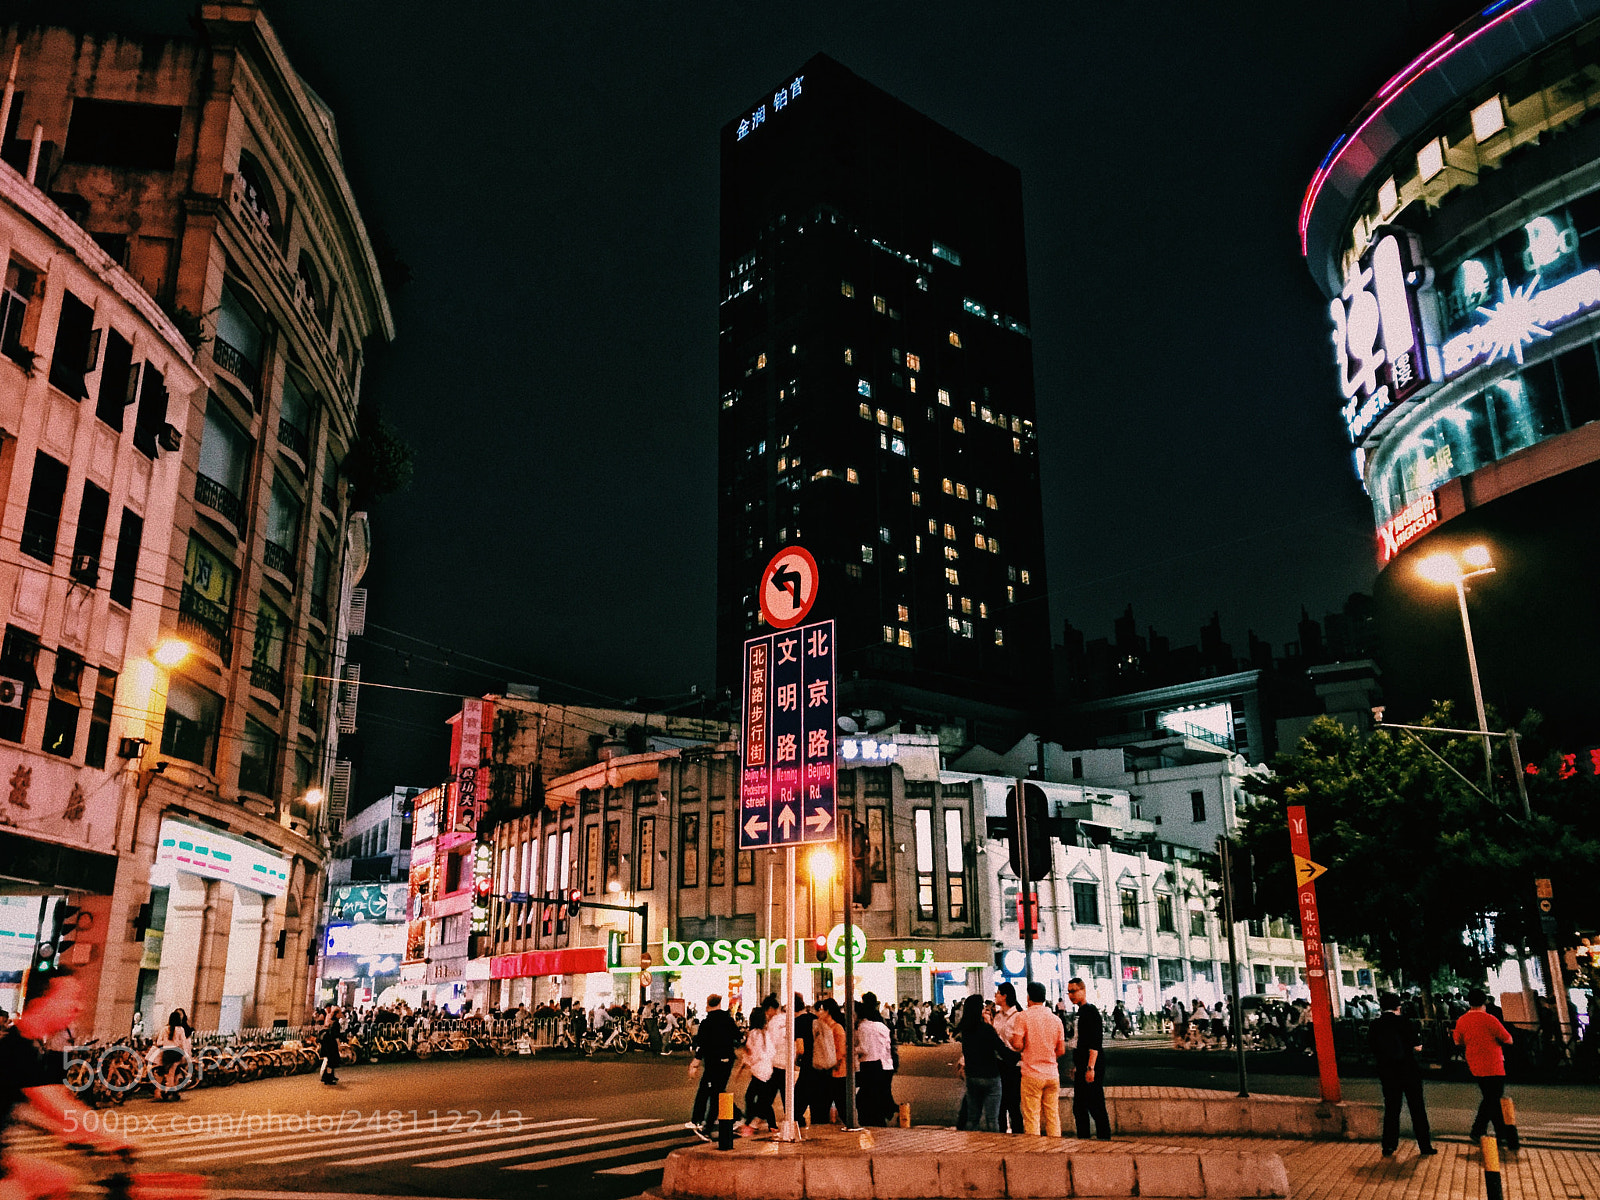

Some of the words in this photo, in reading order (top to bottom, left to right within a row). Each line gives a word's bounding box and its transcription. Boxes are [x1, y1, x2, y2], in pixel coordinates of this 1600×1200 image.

[750, 648, 765, 762] 北京路步行街
[777, 637, 798, 763] 文明路
[807, 629, 830, 759] 北京路
[807, 762, 831, 781] Beijing
[743, 783, 769, 796] Pedestrian
[745, 796, 767, 809] street
[780, 786, 796, 803] Rd.
[809, 784, 822, 800] Rd.
[662, 927, 805, 966] bossini
[1304, 909, 1321, 966] 北京路站
